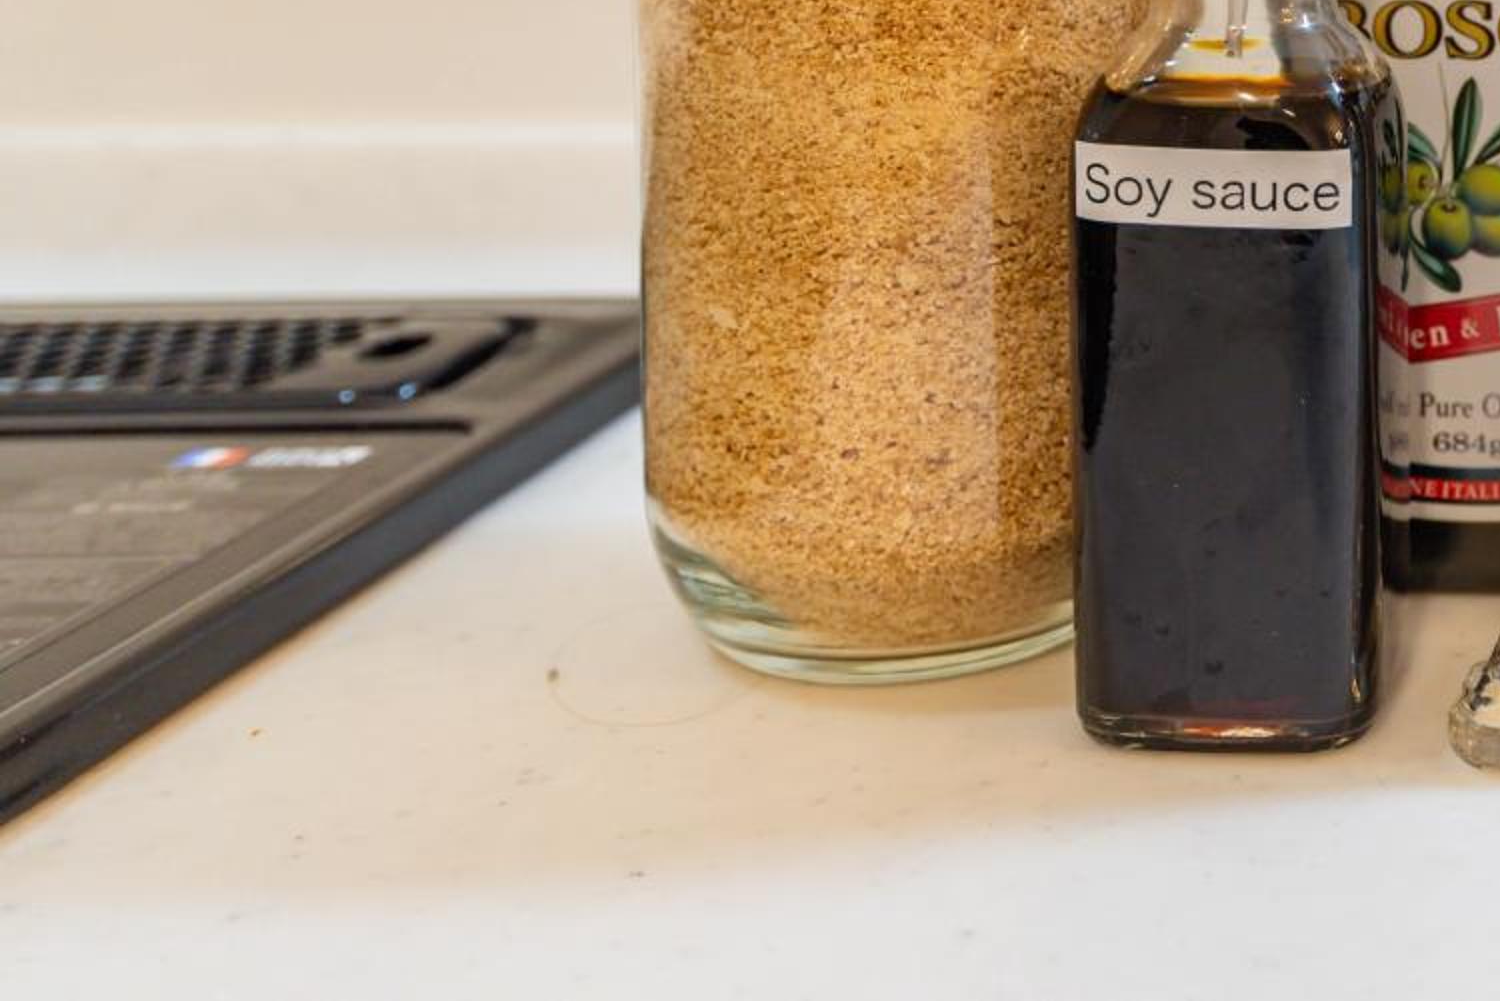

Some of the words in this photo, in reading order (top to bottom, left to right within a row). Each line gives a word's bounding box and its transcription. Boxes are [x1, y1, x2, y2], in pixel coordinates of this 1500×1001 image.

[1085, 163, 1172, 217] Soy
[1192, 179, 1340, 212] sauce
[1460, 316, 1481, 339] &
[1419, 392, 1474, 419] Pure
